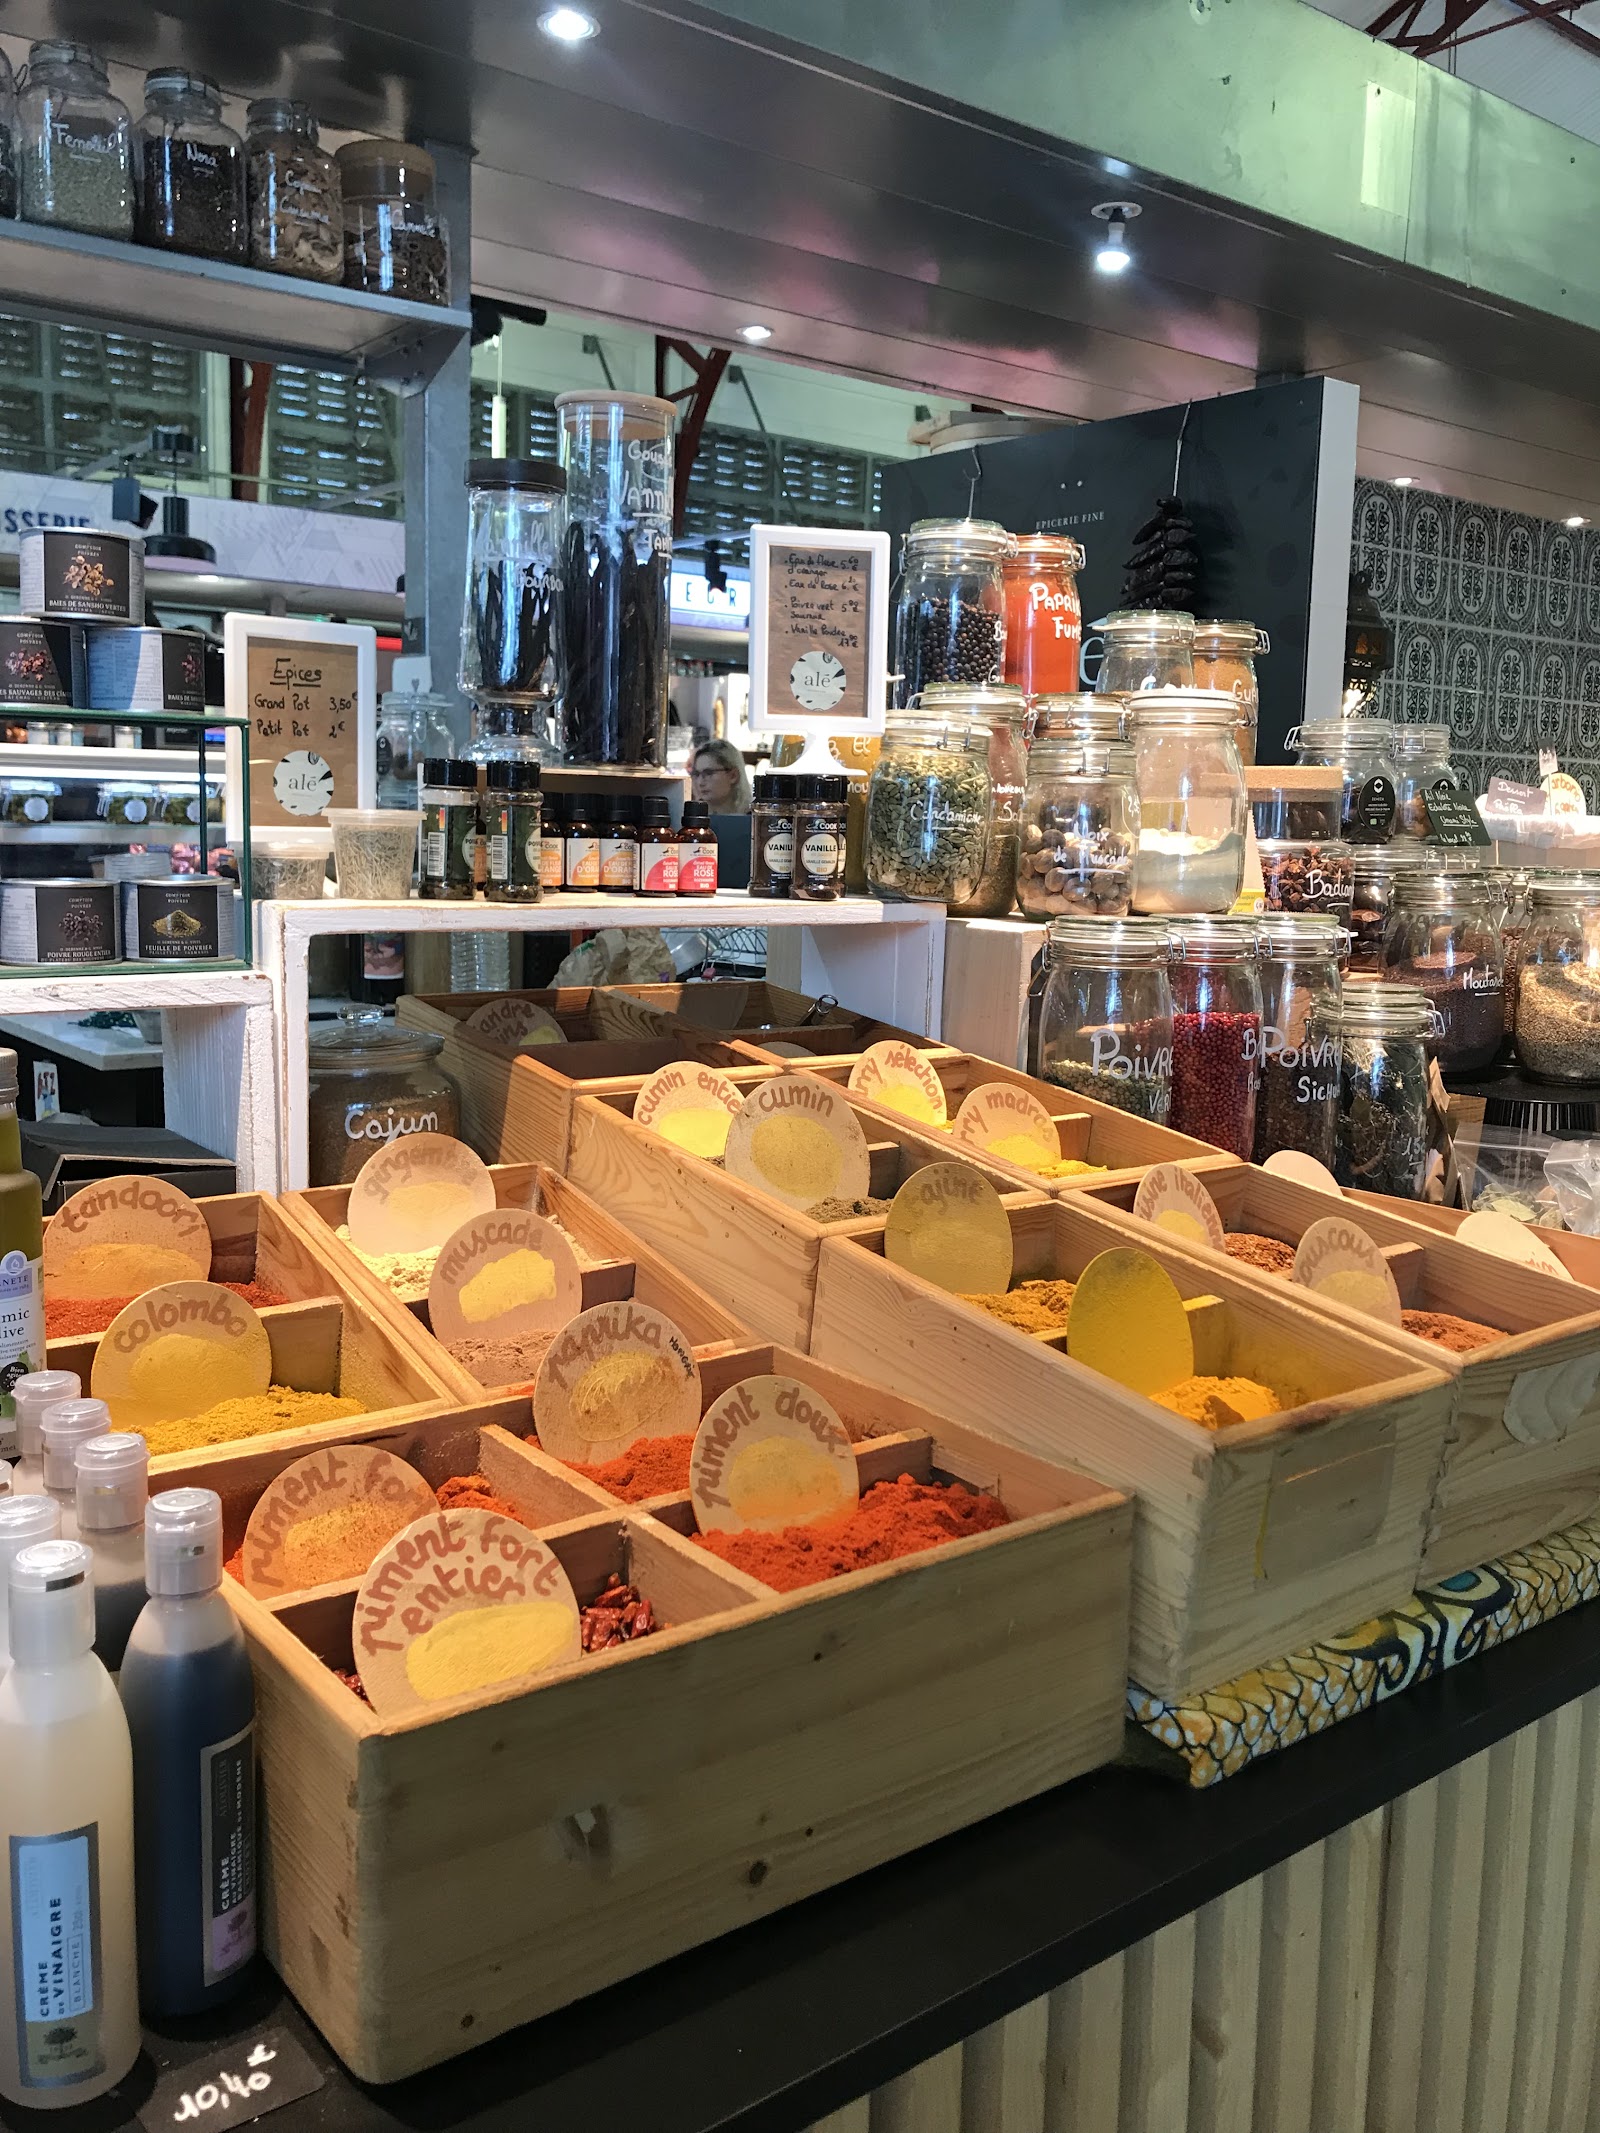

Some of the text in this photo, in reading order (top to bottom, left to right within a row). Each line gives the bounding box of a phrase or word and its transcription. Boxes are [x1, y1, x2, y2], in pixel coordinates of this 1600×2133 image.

[1035, 511, 1105, 530] EPICERIE FINE
[13, 689, 43, 697] SAUVAGES
[274, 658, 322, 690] Epices
[254, 693, 285, 709] Grand
[293, 694, 310, 711] Pot
[257, 719, 283, 737] Petit
[292, 721, 309, 737] Pot
[693, 869, 714, 877] ROSE
[47, 951, 71, 959] POIVRE
[637, 1070, 686, 1126] cumin
[759, 1084, 834, 1118] cumin
[986, 1090, 1055, 1142] madras
[344, 1108, 438, 1145] Cajun
[61, 1181, 207, 1238] tandoori
[440, 1218, 544, 1286] muscade
[113, 1293, 248, 1354] colombo
[774, 1387, 849, 1452] doux
[481, 1516, 559, 1597] fort
[401, 1555, 525, 1635] entier
[50, 1898, 64, 1999] VINAIGRE
[72, 1941, 82, 2002] BLANCHE
[38, 1962, 49, 2017] CRÈME
